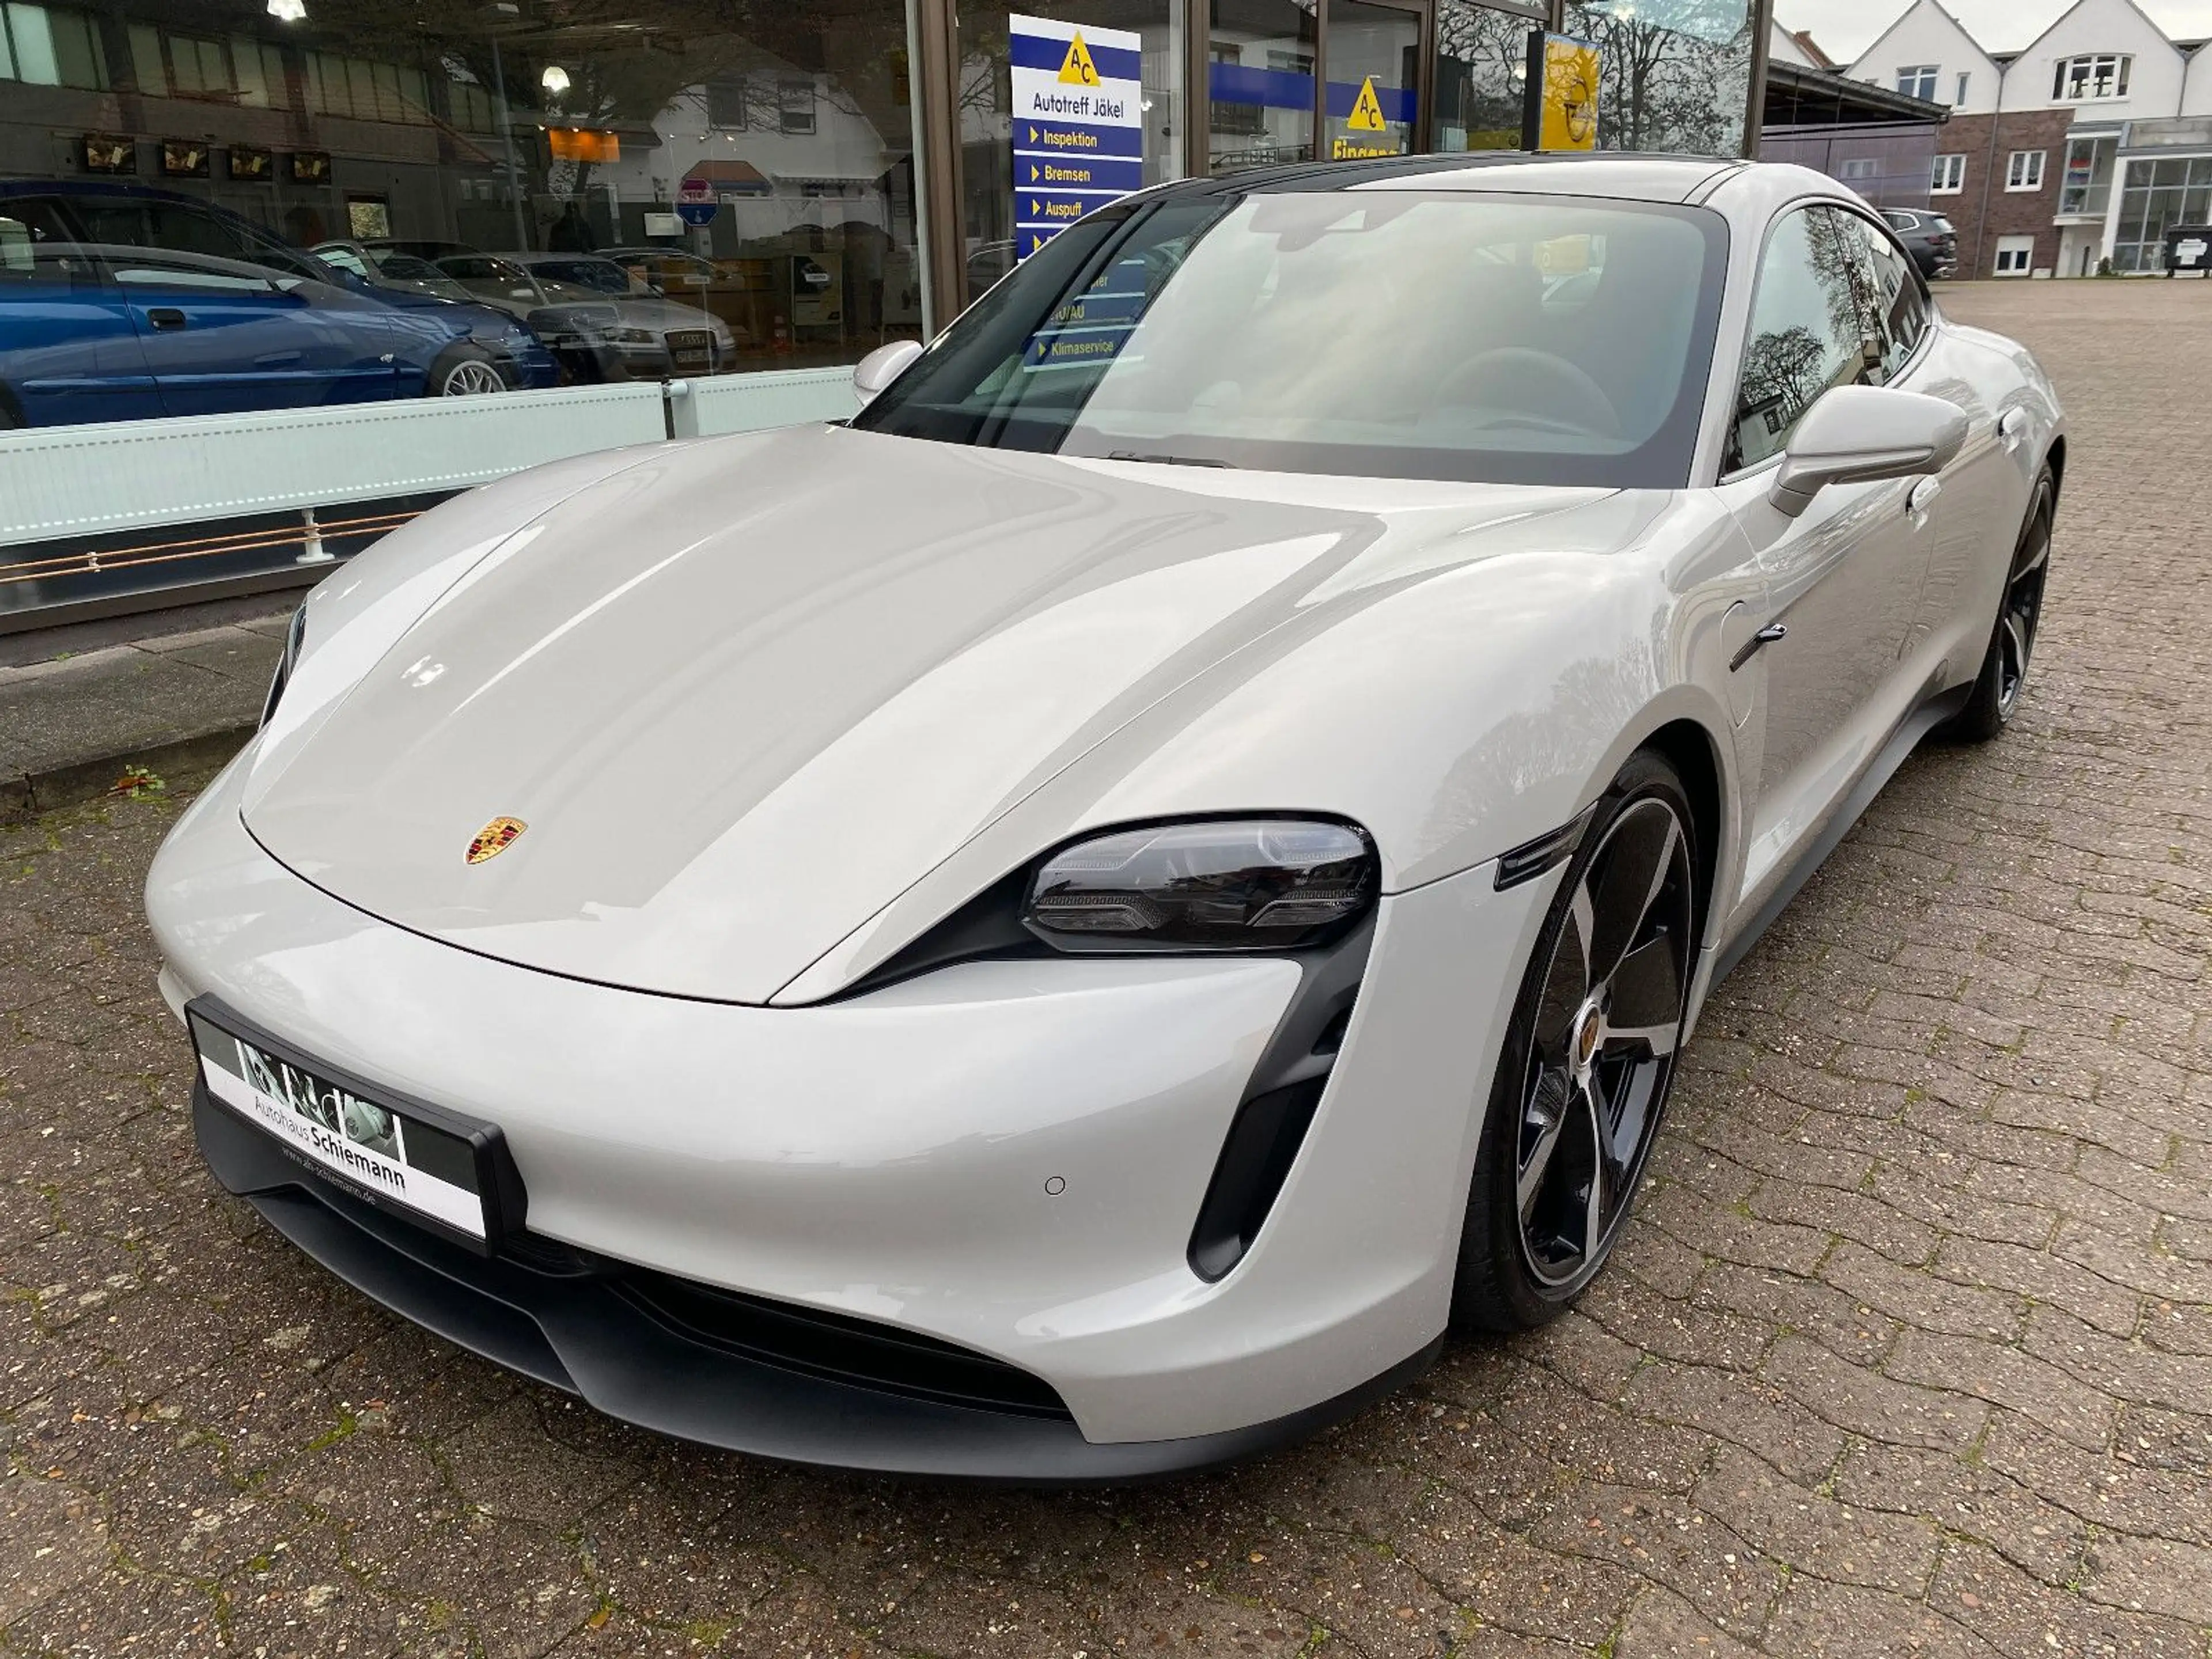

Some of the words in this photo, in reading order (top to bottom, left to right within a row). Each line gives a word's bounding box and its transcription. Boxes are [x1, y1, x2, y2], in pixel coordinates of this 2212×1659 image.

[1033, 93, 1090, 115] Autotreff
[1093, 99, 1123, 119] Jäkel
[1044, 129, 1097, 148] Inspektion
[1044, 164, 1090, 181] Bremsen
[1045, 200, 1082, 219] Auspuff
[1051, 339, 1113, 356] Klimaservice
[255, 1096, 309, 1141] Autohaus
[311, 1126, 406, 1188] Schiemann
